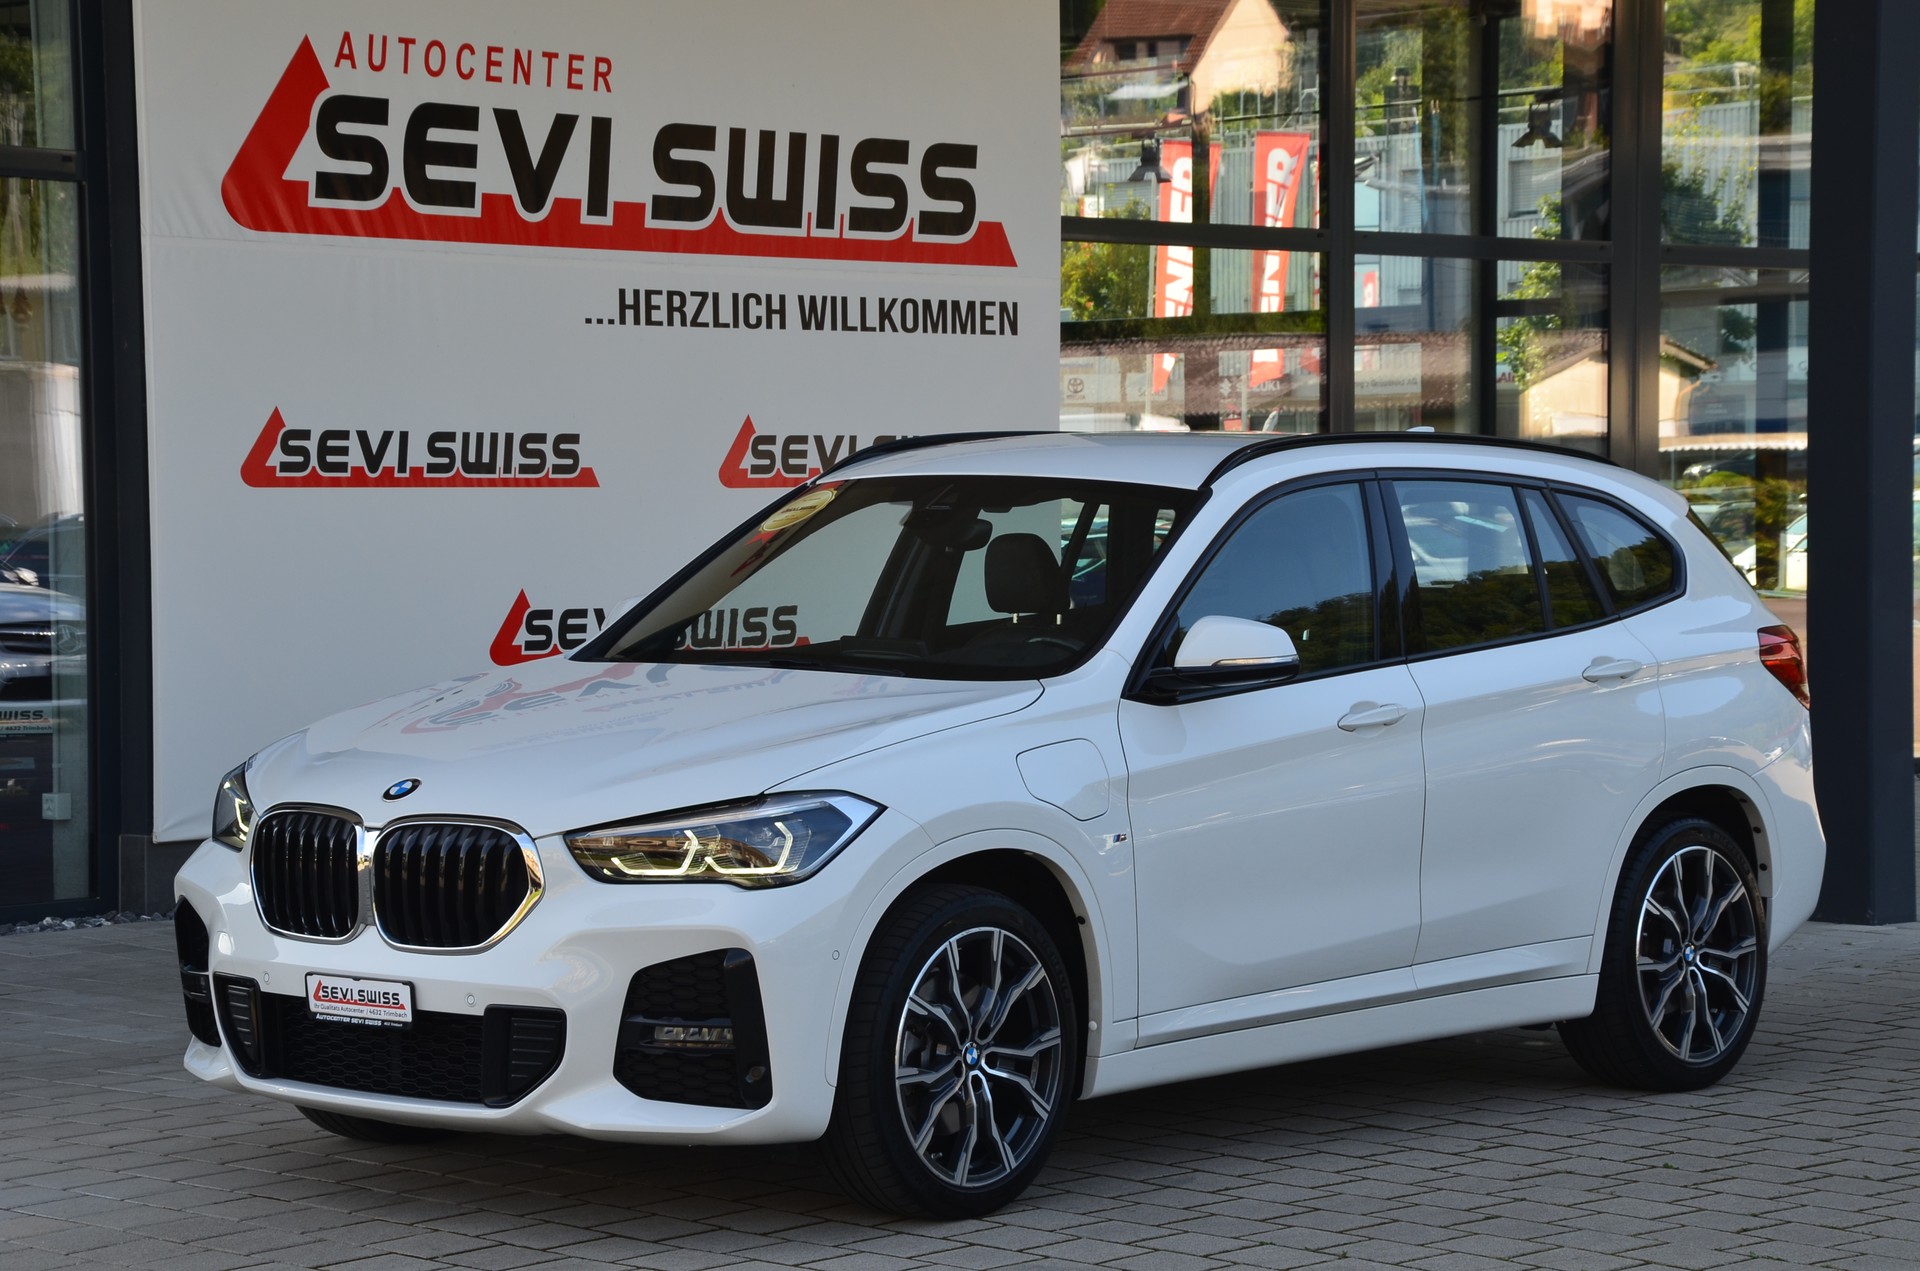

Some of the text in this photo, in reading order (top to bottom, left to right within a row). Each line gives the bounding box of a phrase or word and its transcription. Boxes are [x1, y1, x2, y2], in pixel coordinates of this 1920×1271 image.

[335, 32, 612, 93] AUTOCENTER
[315, 95, 977, 237] SEVI SWISS
[798, 295, 1018, 336] WILLKOMMEN
[279, 429, 580, 475] SEVI SWISS
[674, 605, 798, 651] WISS
[322, 986, 400, 1006] SEVI SWISS
[341, 1006, 365, 1014] Autocenter
